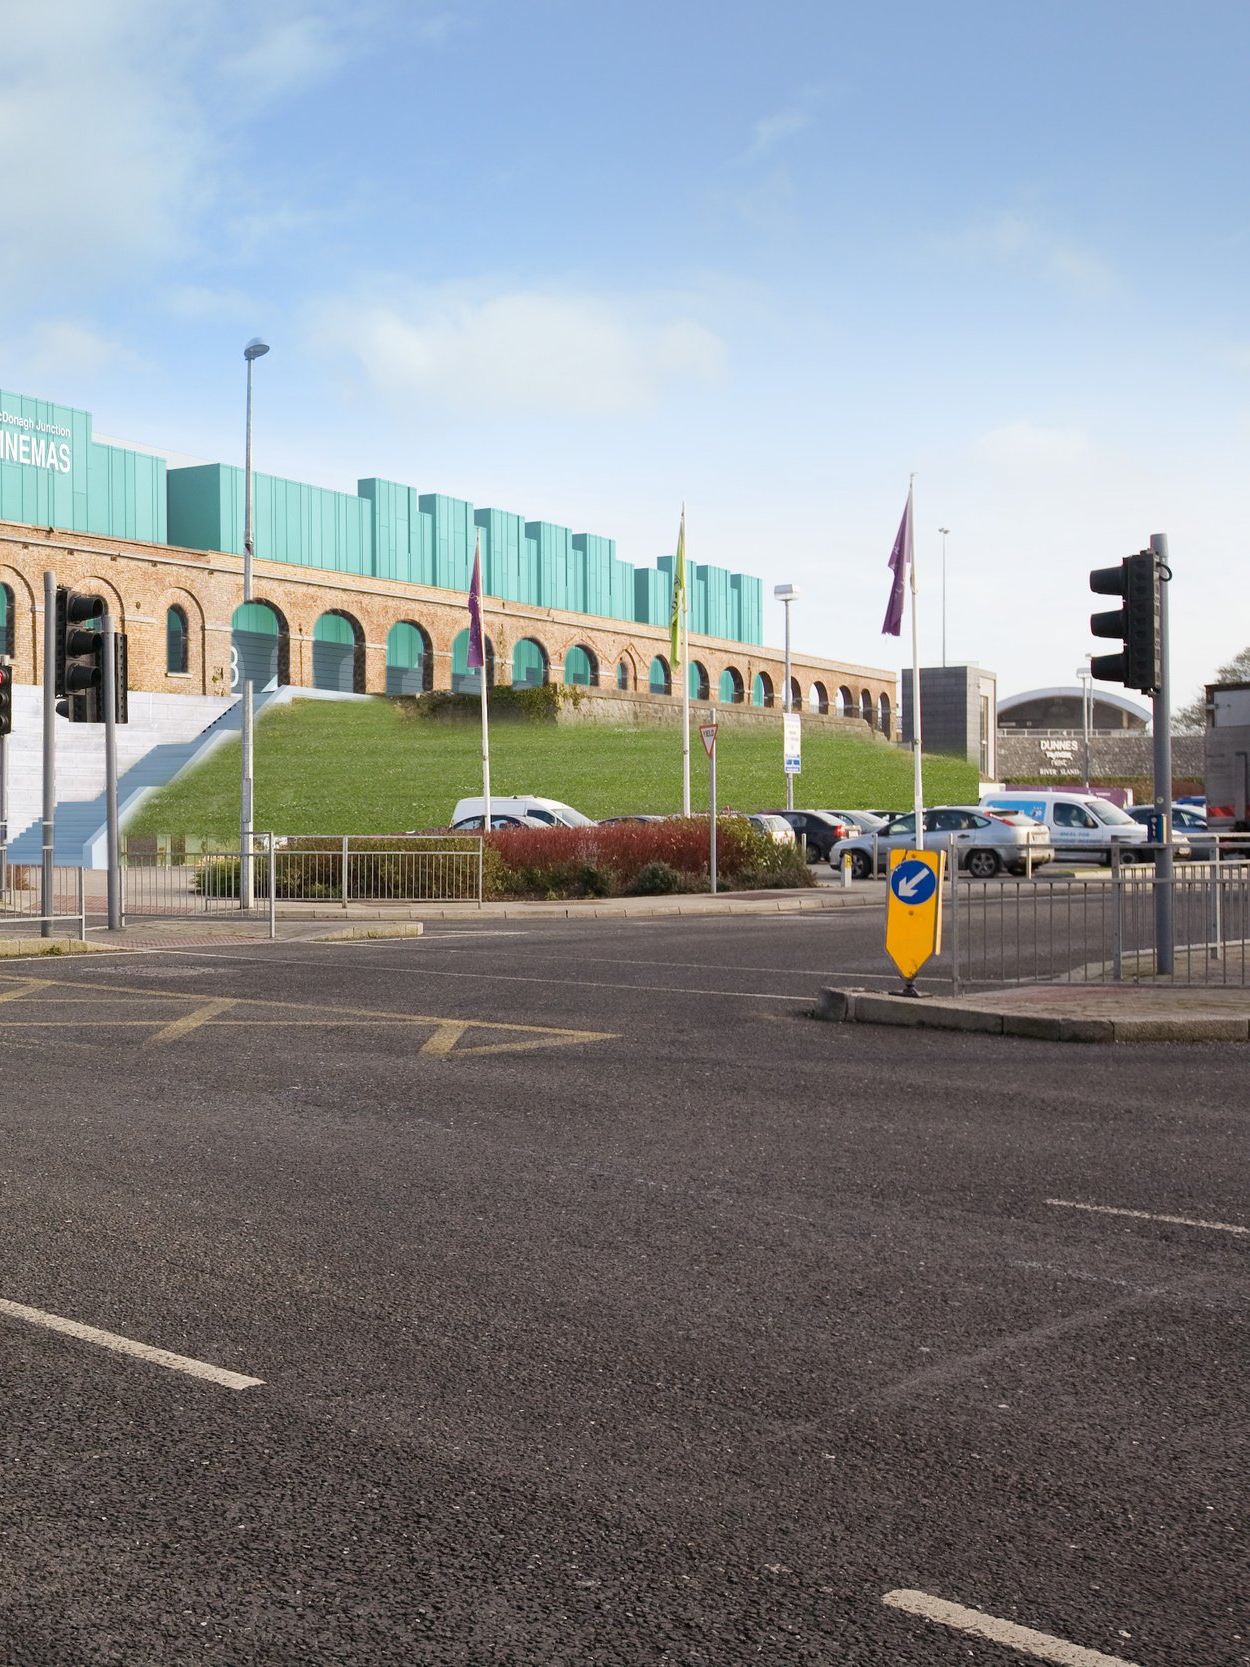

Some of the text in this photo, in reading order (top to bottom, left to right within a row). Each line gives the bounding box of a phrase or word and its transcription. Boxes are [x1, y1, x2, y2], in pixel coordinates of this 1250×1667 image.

[36, 420, 71, 438] Junction
[702, 728, 715, 738] YIELD
[1040, 739, 1078, 751] DUNNES
[1039, 768, 1057, 776] RIVER
